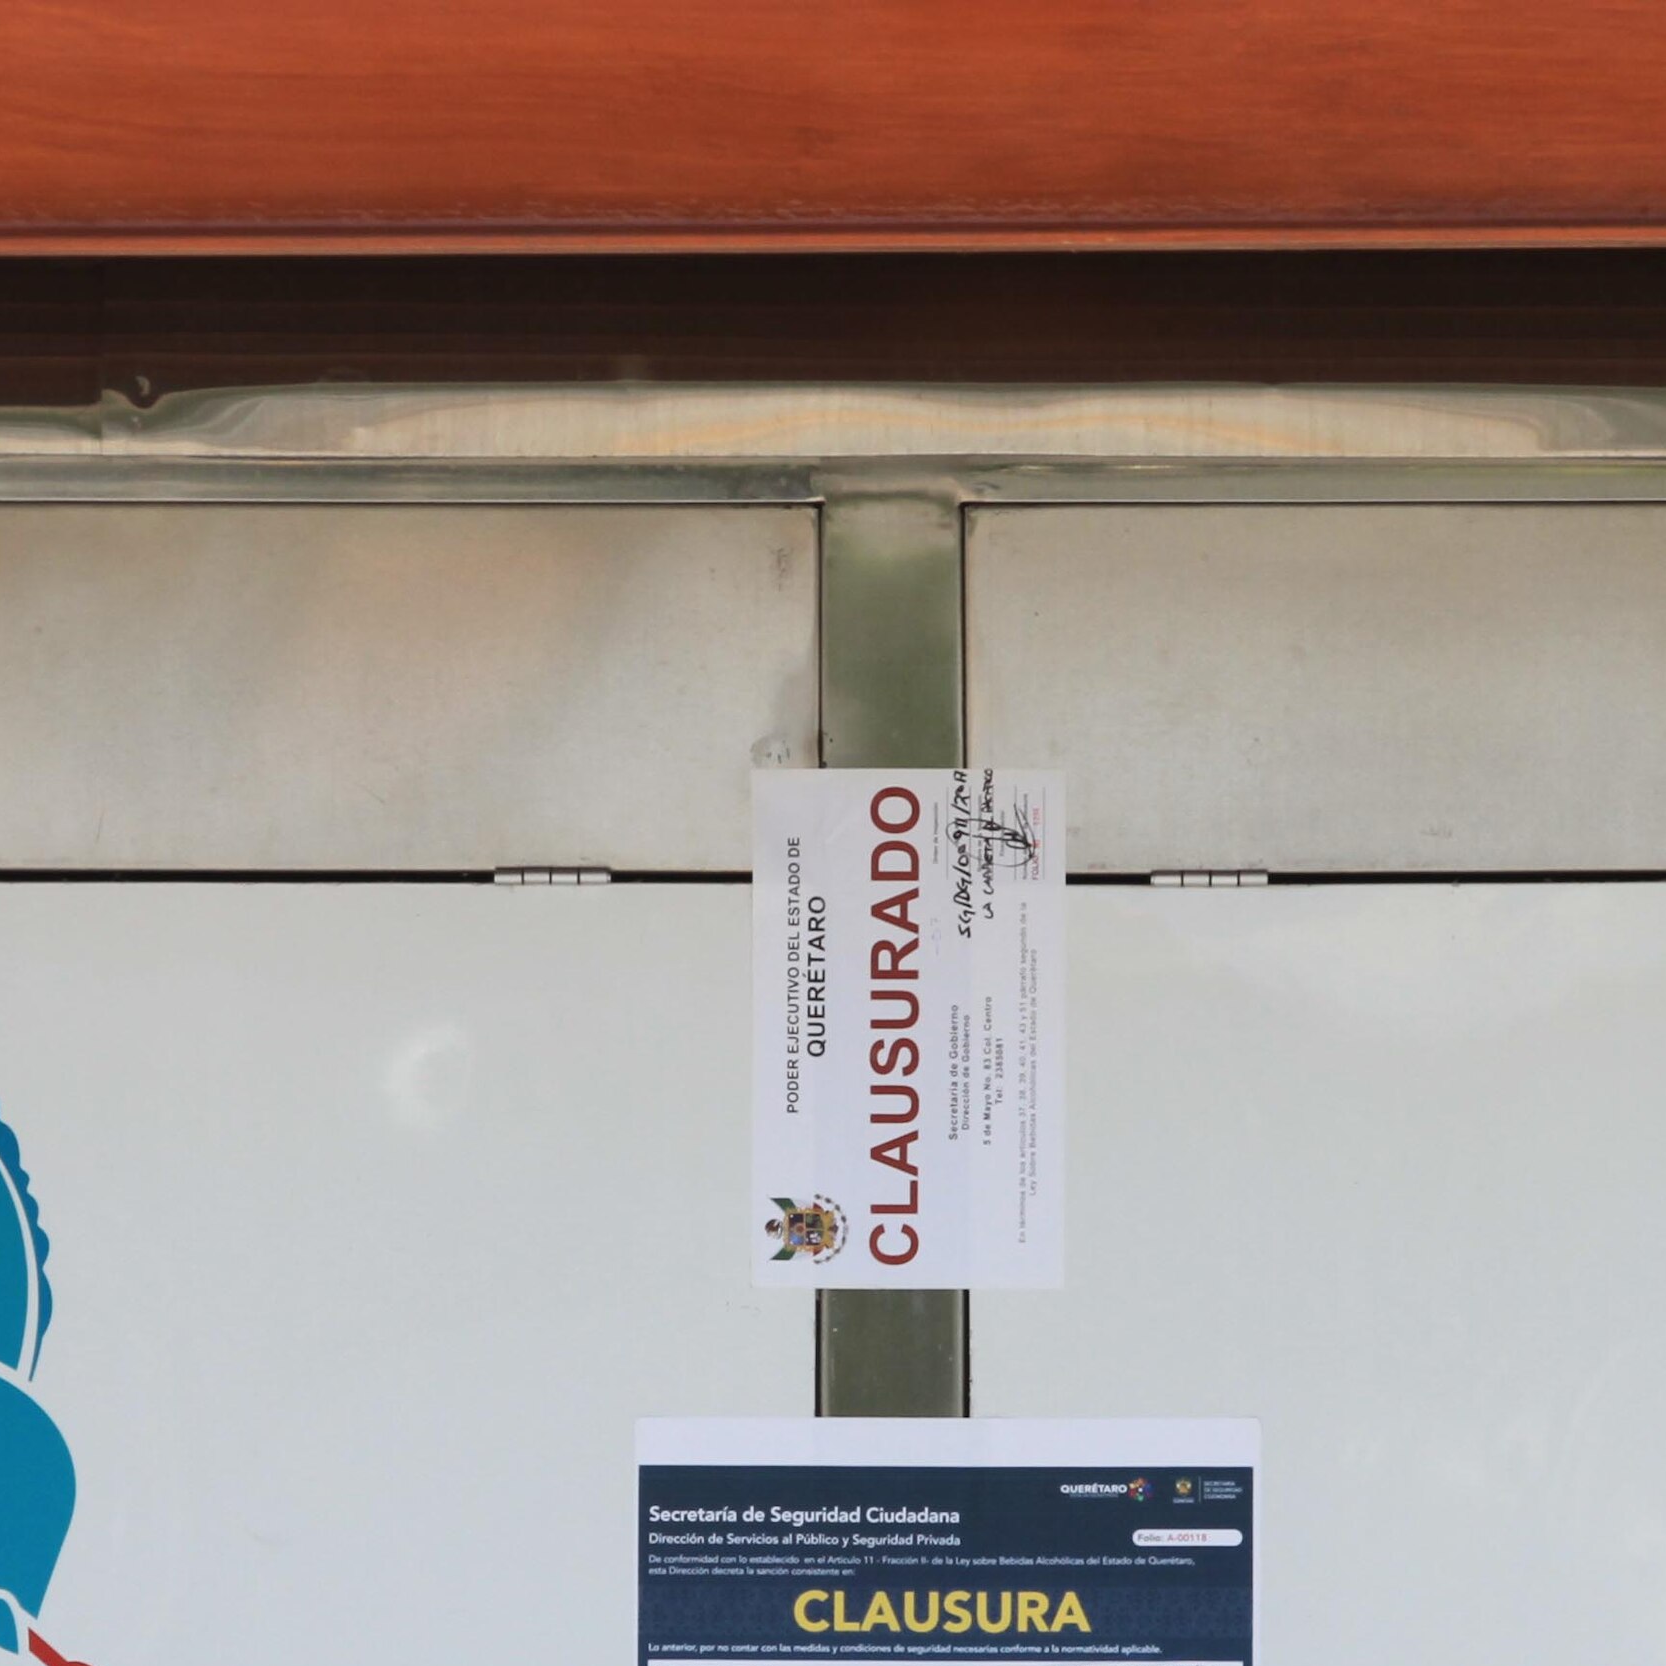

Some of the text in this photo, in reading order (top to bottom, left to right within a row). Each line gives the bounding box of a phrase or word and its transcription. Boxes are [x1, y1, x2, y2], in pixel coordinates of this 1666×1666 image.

[787, 837, 800, 1113] PODER EJECUTIVO DEL ESTADO DE
[803, 896, 825, 1057] QUERÉTARO
[870, 786, 920, 1265] CLAUSURADO
[949, 1005, 958, 1140] Secretaria de Gobierno
[961, 1014, 970, 1130] Dirección de Gobierno
[649, 1505, 960, 1527] Secretaría de Seguridad Ciudadana
[1060, 1483, 1128, 1494] QUERÉTARO
[649, 1532, 961, 1548] Dirección de Servicios al Público y Seguridad Privada
[648, 1643, 660, 1652] Lo
[661, 1644, 698, 1652] anterior,
[699, 1645, 715, 1654] por
[731, 1644, 759, 1652] contar
[779, 1643, 792, 1652] las
[793, 1644, 830, 1652] medidas
[832, 1646, 838, 1654] y
[840, 1644, 891, 1652] condiciones
[893, 1644, 905, 1653] de
[907, 1644, 951, 1655] seguridad
[953, 1645, 998, 1653] necesarias
[1000, 1644, 1042, 1653] conforme
[1051, 1644, 1060, 1653] la
[1061, 1644, 1119, 1653] normatividad
[1121, 1645, 1162, 1655] aplicable.
[794, 1590, 1091, 1633] CLAUSURA
